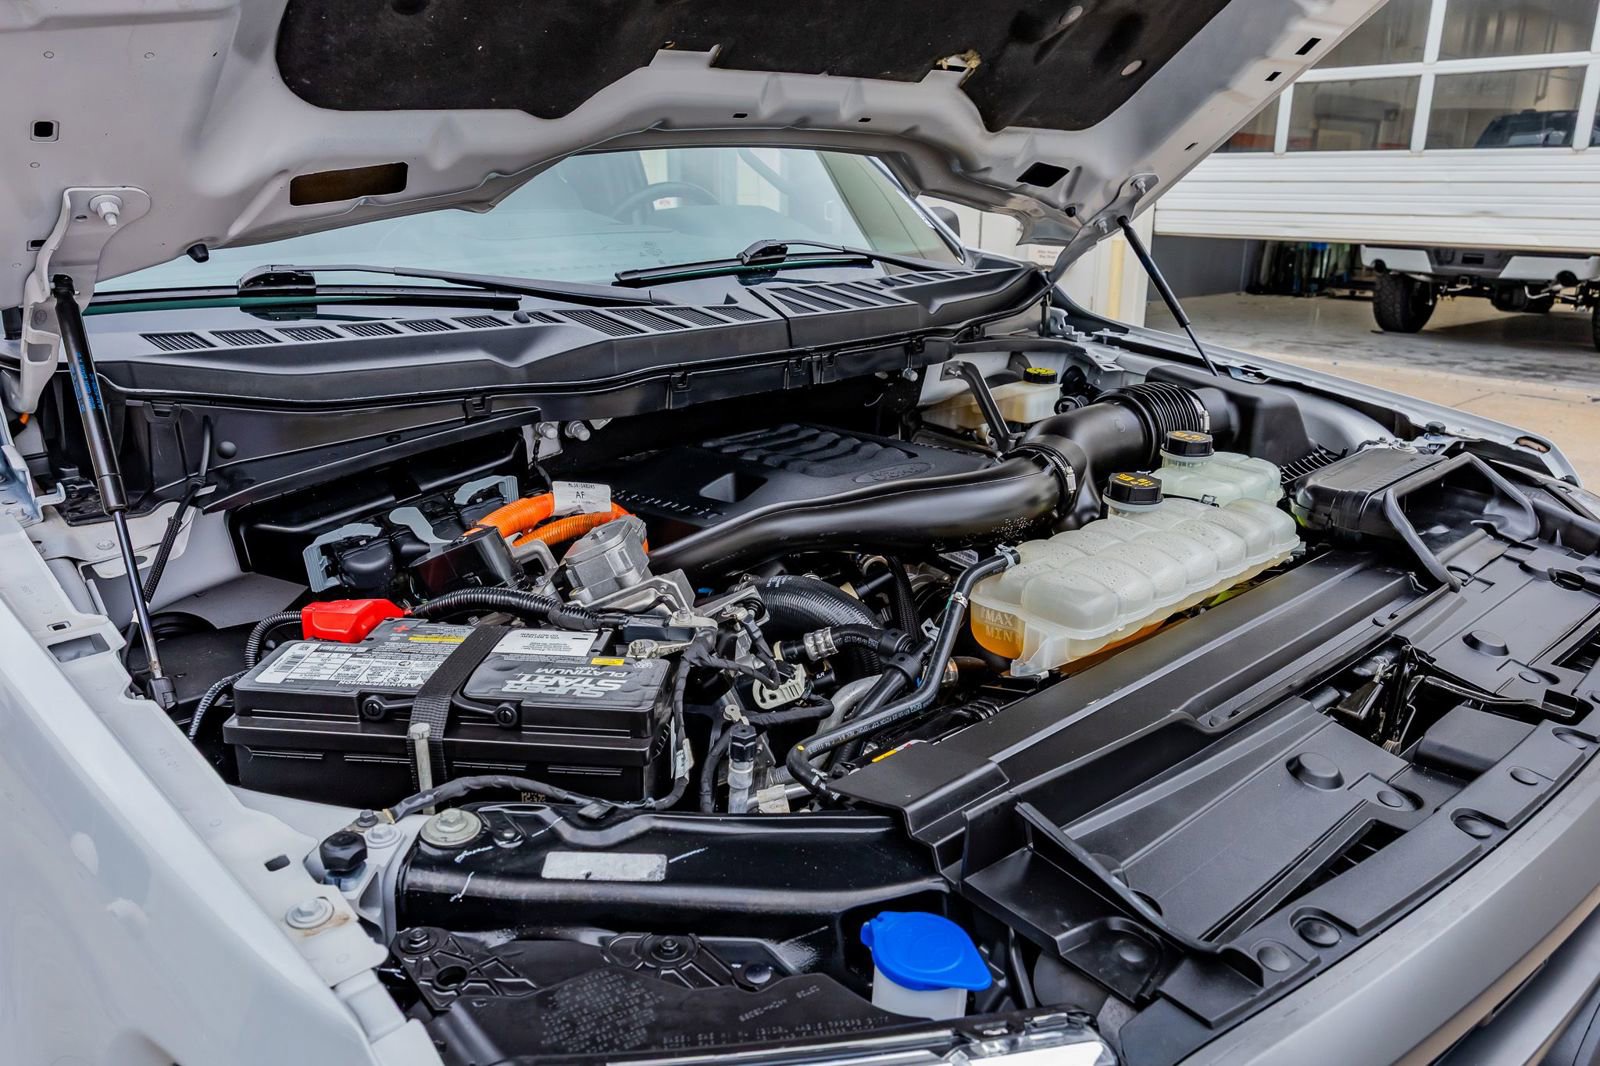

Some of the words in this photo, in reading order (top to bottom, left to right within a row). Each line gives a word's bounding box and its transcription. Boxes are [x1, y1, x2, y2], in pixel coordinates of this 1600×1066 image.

[576, 491, 584, 499] AF
[984, 607, 1013, 627] MAX
[985, 624, 1014, 642] MIN
[535, 667, 628, 678] PLATINUM
[501, 679, 605, 698] SUPER
[513, 672, 628, 692] START
